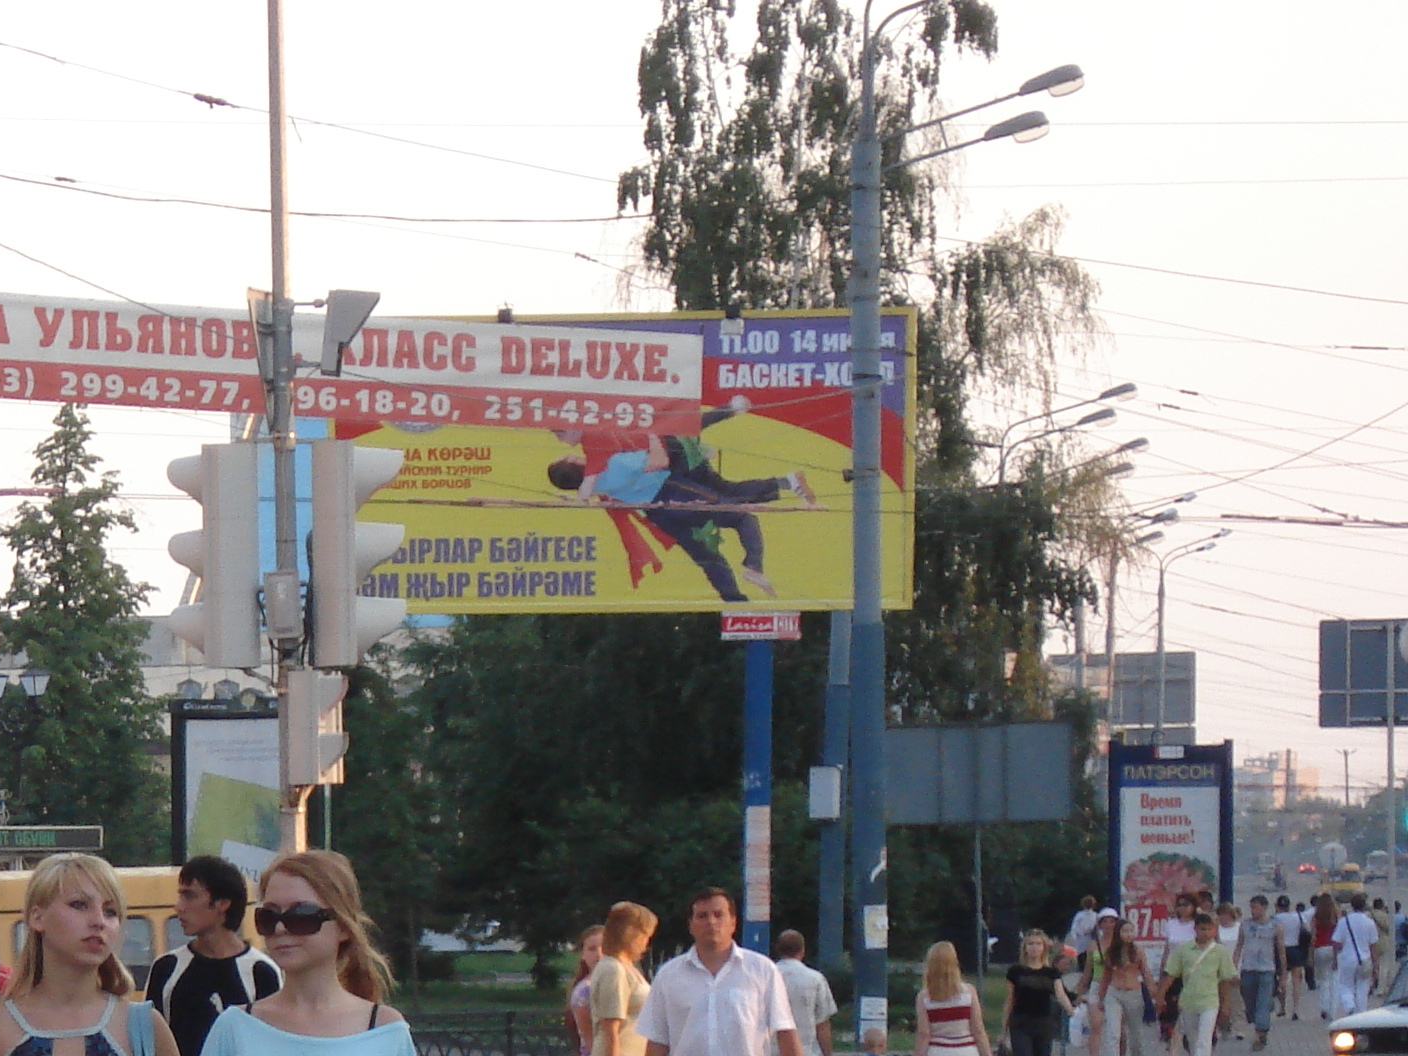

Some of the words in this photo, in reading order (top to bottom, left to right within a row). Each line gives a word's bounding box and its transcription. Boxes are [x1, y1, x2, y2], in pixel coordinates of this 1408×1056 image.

[791, 330, 818, 353] 14
[501, 336, 681, 384] DELUXE.
[60, 371, 252, 411] 299-42-77,
[485, 395, 655, 428] 251-42-93
[489, 531, 598, 563] БӘЙГЕСЕ
[477, 566, 596, 597] БӘЙРӘМЕ
